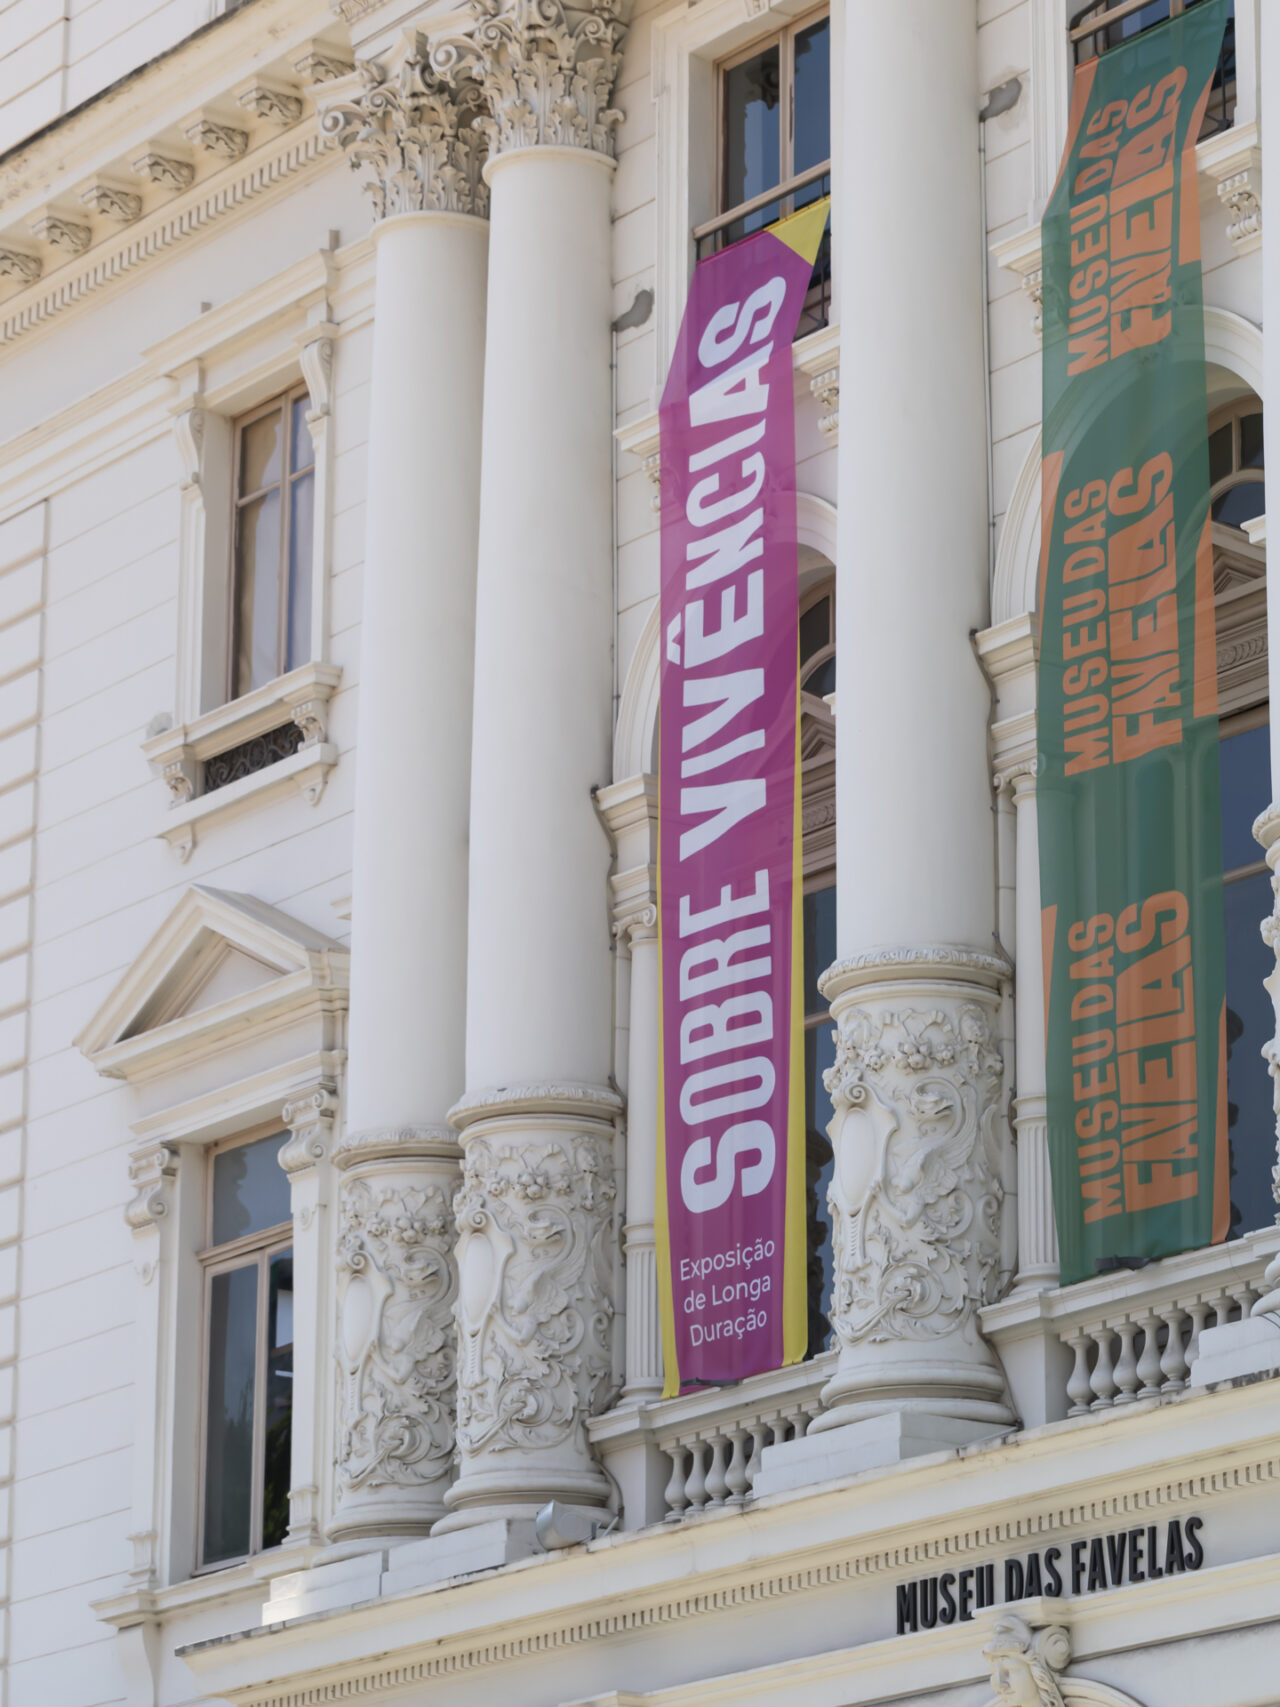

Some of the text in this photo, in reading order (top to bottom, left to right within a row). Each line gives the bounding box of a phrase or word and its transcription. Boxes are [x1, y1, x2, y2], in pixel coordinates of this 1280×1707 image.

[1067, 99, 1128, 376] MUSEU DAS
[1109, 65, 1188, 360] FAVELAS
[666, 275, 786, 1214] SOBRE VIVÊNCIAS
[1062, 478, 1110, 776] MUSEU DAS
[1108, 451, 1183, 764] FAVELAS
[1067, 912, 1123, 1224] MUSEU DAS
[1115, 890, 1199, 1213] FAVELAS
[679, 1237, 775, 1281] Exposição
[683, 1275, 771, 1314] de Longa
[689, 1308, 767, 1347] Duração
[896, 1516, 1204, 1635] MUSEU DAS FAVELAS
